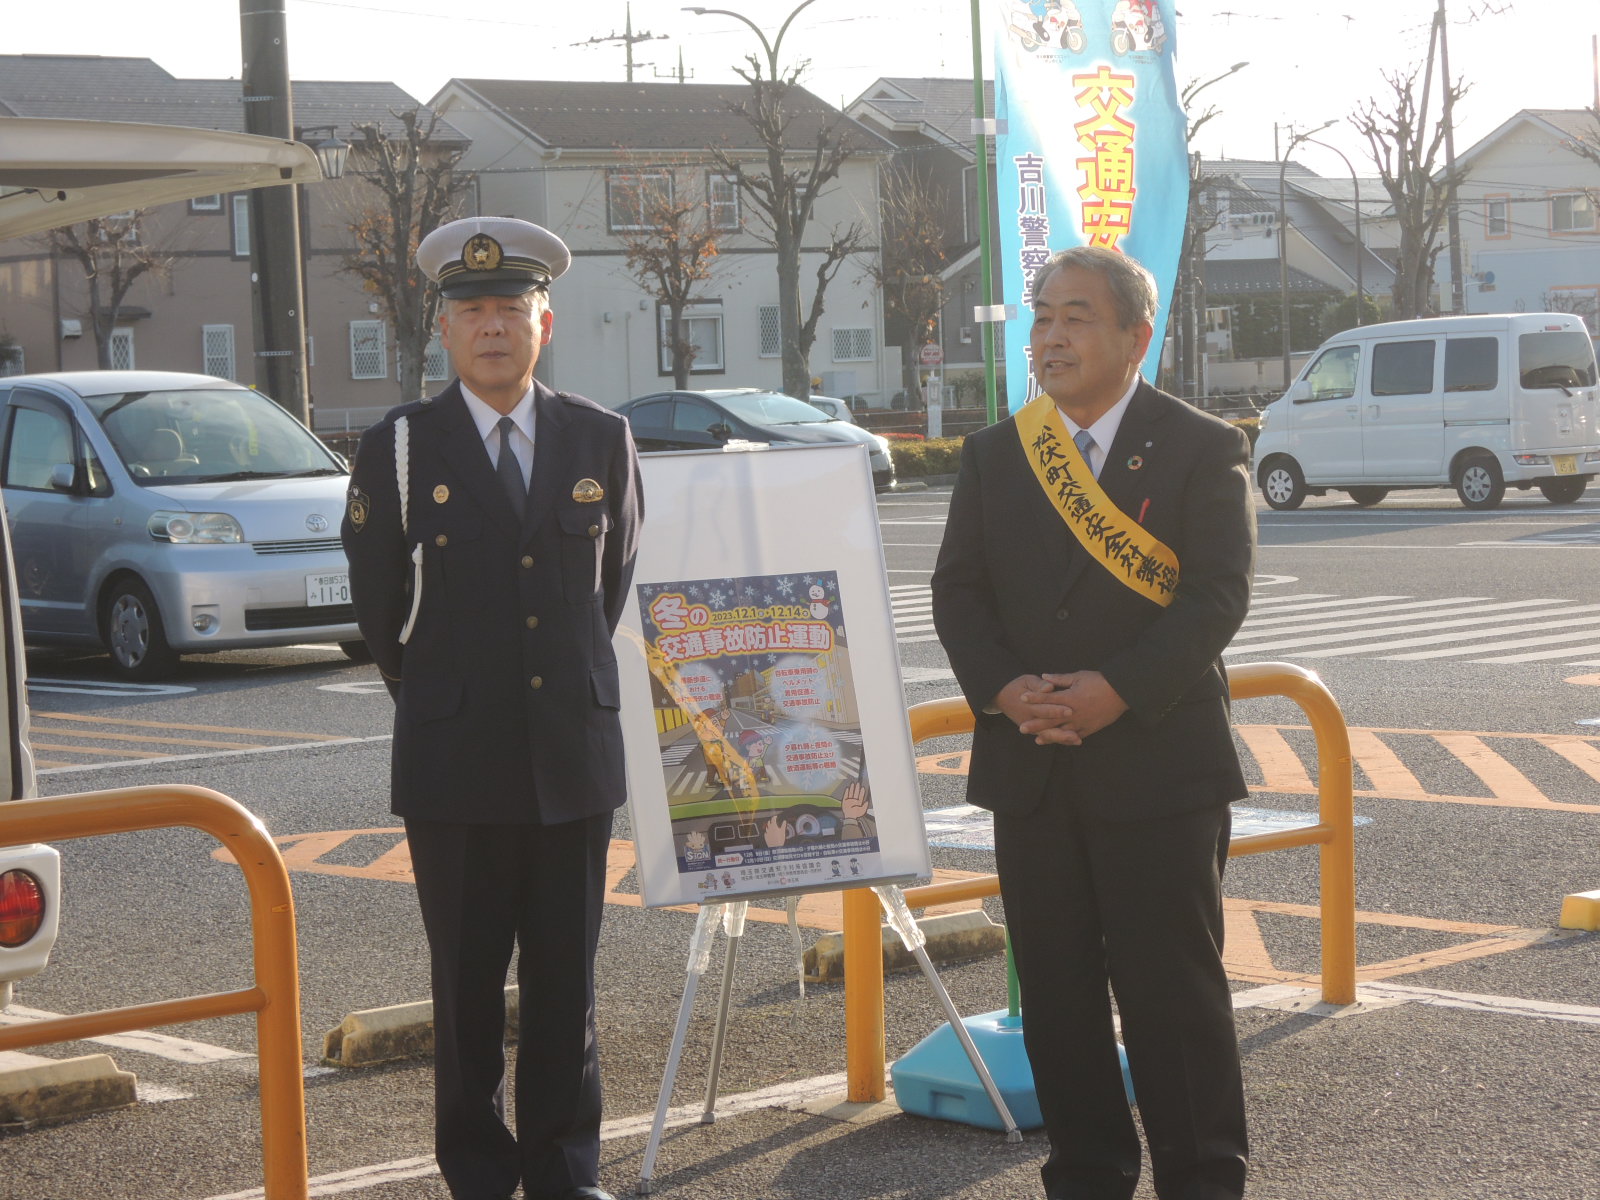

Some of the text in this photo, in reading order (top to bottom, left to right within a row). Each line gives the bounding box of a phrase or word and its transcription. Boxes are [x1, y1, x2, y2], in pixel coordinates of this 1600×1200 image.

[321, 586, 348, 603] 11-0
[653, 597, 707, 629] 冬の
[658, 624, 831, 662] 交通事故防止運動
[783, 698, 820, 707] 交通事故防止
[786, 752, 834, 761] 交通事故防止及び
